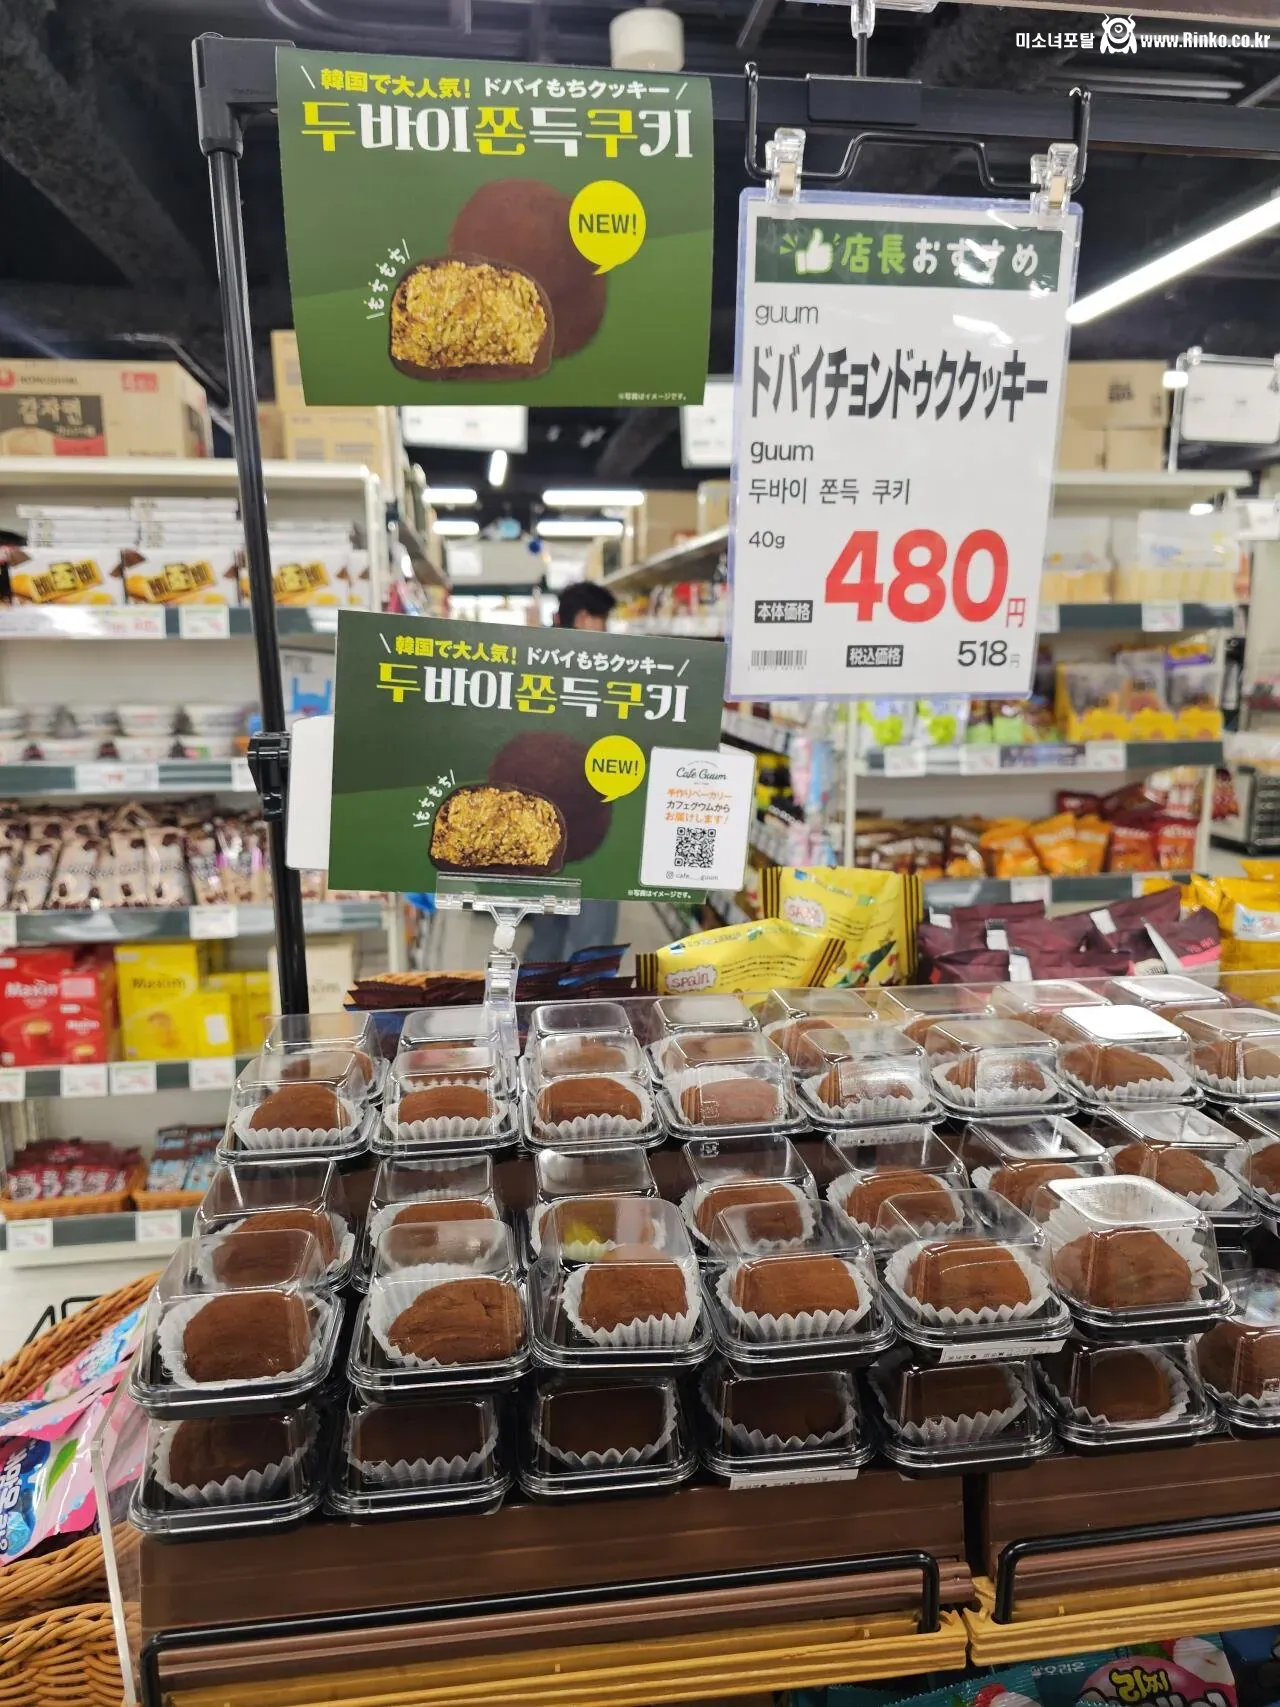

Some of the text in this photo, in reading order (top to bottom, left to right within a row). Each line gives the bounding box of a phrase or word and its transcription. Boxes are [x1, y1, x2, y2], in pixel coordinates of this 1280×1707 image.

[483, 77, 670, 99] ドバイもちクッキー
[301, 101, 694, 158] 두바이쫀득쿠키
[577, 213, 637, 235] NEW!
[365, 247, 405, 311] もちもち
[755, 304, 819, 326] guum
[751, 345, 1048, 422] ドバイチョンドゥククッキー
[750, 441, 815, 464] guum
[749, 477, 910, 505] 두바이 쫀득 쿠키
[748, 530, 786, 549] 40g
[756, 602, 811, 622] 本体価格
[526, 647, 675, 675] ドバイもちクッキー
[848, 647, 902, 666] 税込価格
[376, 661, 690, 723] 두바이쫀득쿠키
[591, 758, 640, 776] NEW!
[676, 766, 697, 780] Cafe
[416, 774, 454, 822] もちもち
[665, 800, 731, 814] カフェグウムから
[626, 888, 693, 899] ※写真はイメージです。
[1044, 1661, 1086, 1676] 오리온
